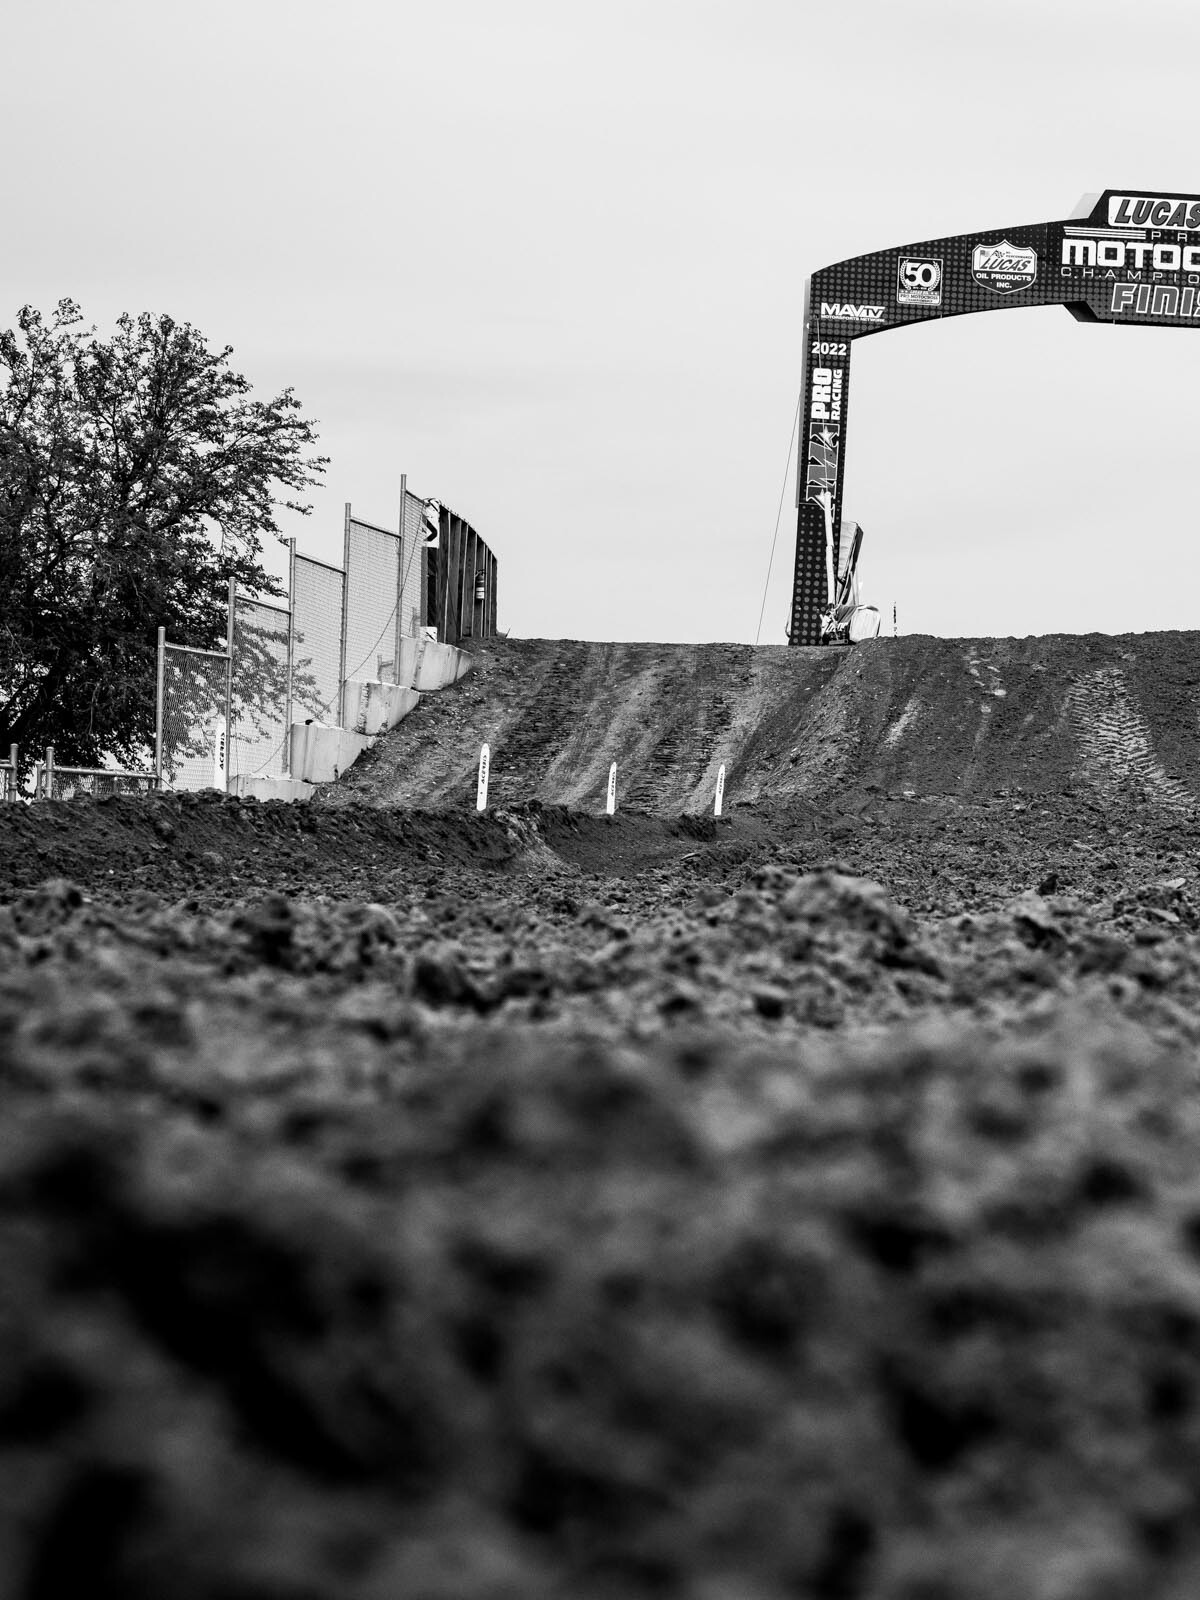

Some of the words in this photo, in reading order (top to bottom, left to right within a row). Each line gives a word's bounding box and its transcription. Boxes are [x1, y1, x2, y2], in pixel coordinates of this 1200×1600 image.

[980, 257, 1031, 272] LUCAS
[904, 262, 938, 287] 50
[991, 273, 1032, 282] PRODUCTS
[996, 281, 1012, 289] INC.
[811, 341, 847, 356] 2022
[811, 367, 832, 420] PRO
[831, 369, 843, 421] RACING
